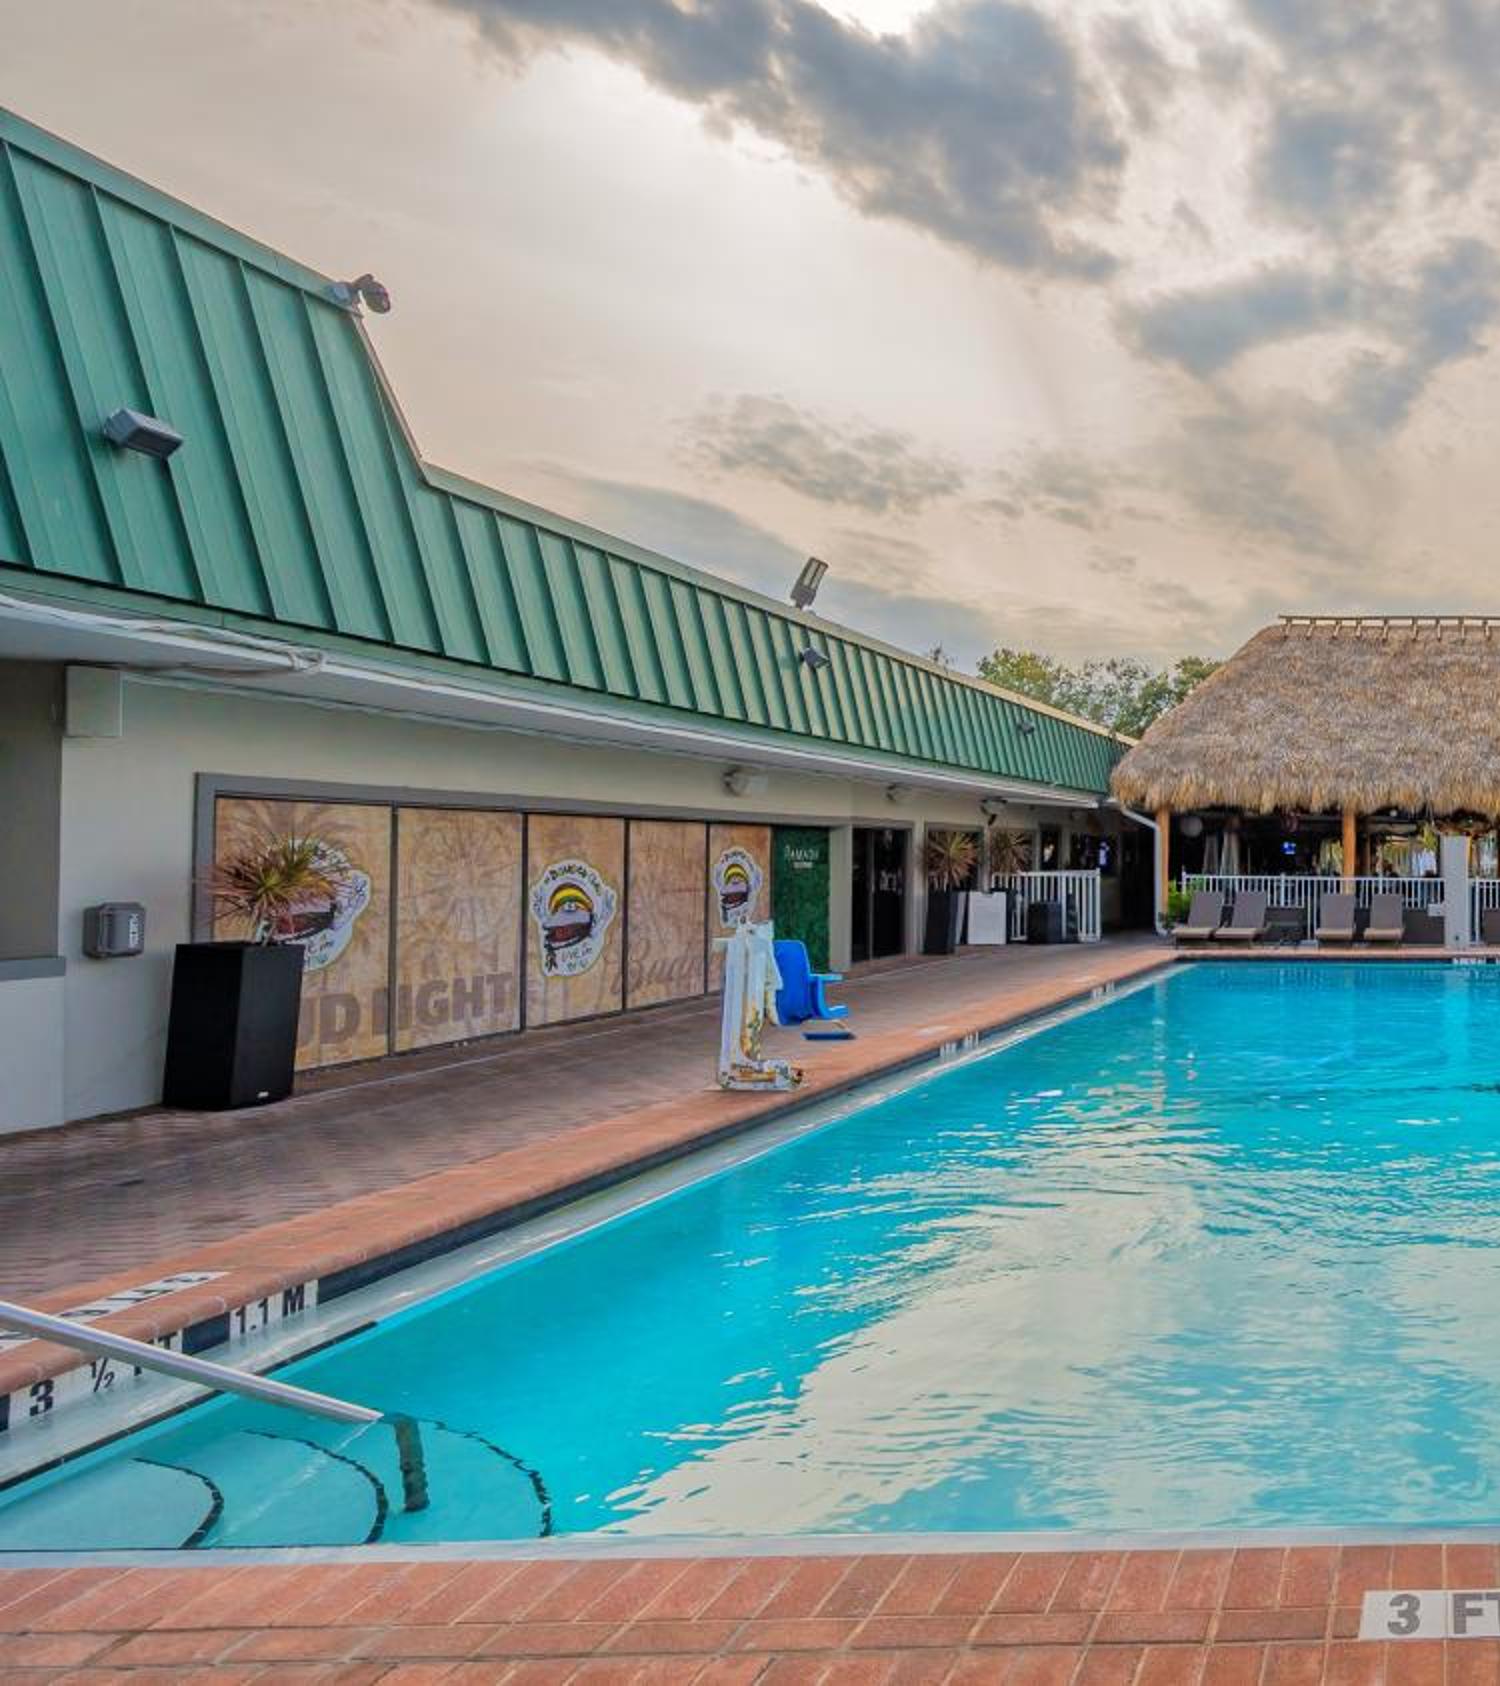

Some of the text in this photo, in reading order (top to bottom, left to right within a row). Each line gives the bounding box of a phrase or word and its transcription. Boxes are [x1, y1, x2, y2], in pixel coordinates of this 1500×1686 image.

[235, 1296, 269, 1334] 1.1
[29, 1378, 55, 1417] 3
[1387, 1593, 1422, 1636] 3
